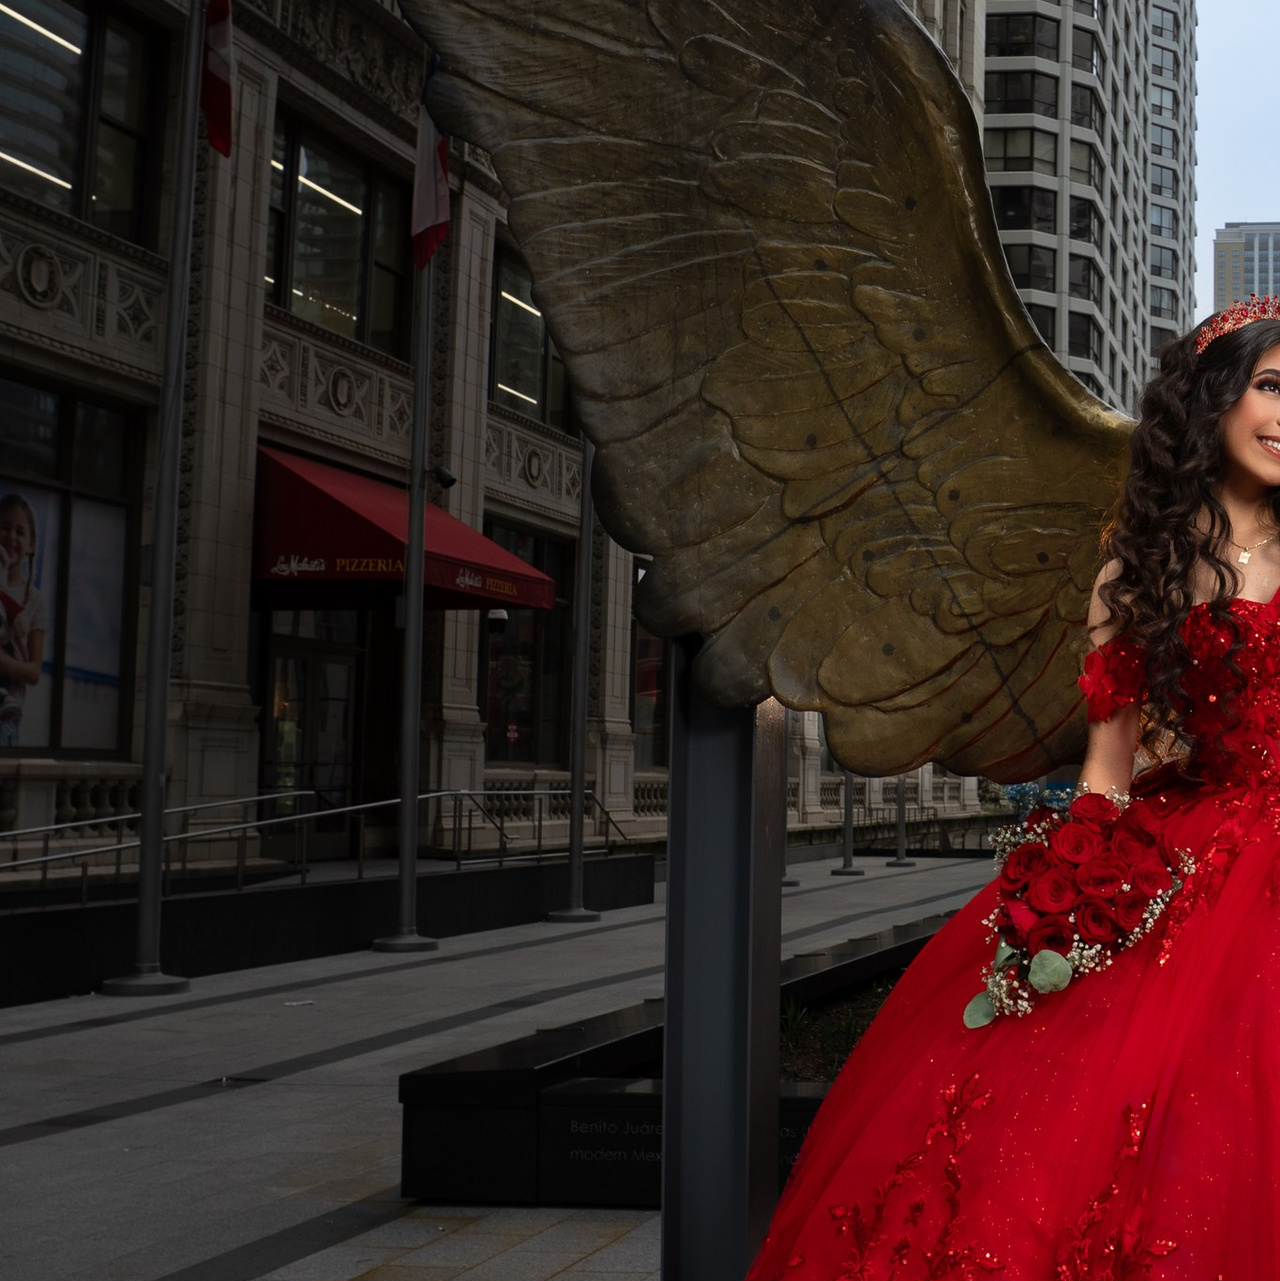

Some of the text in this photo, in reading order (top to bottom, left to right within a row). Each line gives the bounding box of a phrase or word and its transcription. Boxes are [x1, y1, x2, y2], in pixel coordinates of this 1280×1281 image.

[335, 558, 404, 572] PIZZERIA
[570, 1120, 618, 1135] Benito
[622, 1120, 662, 1135] Juáre
